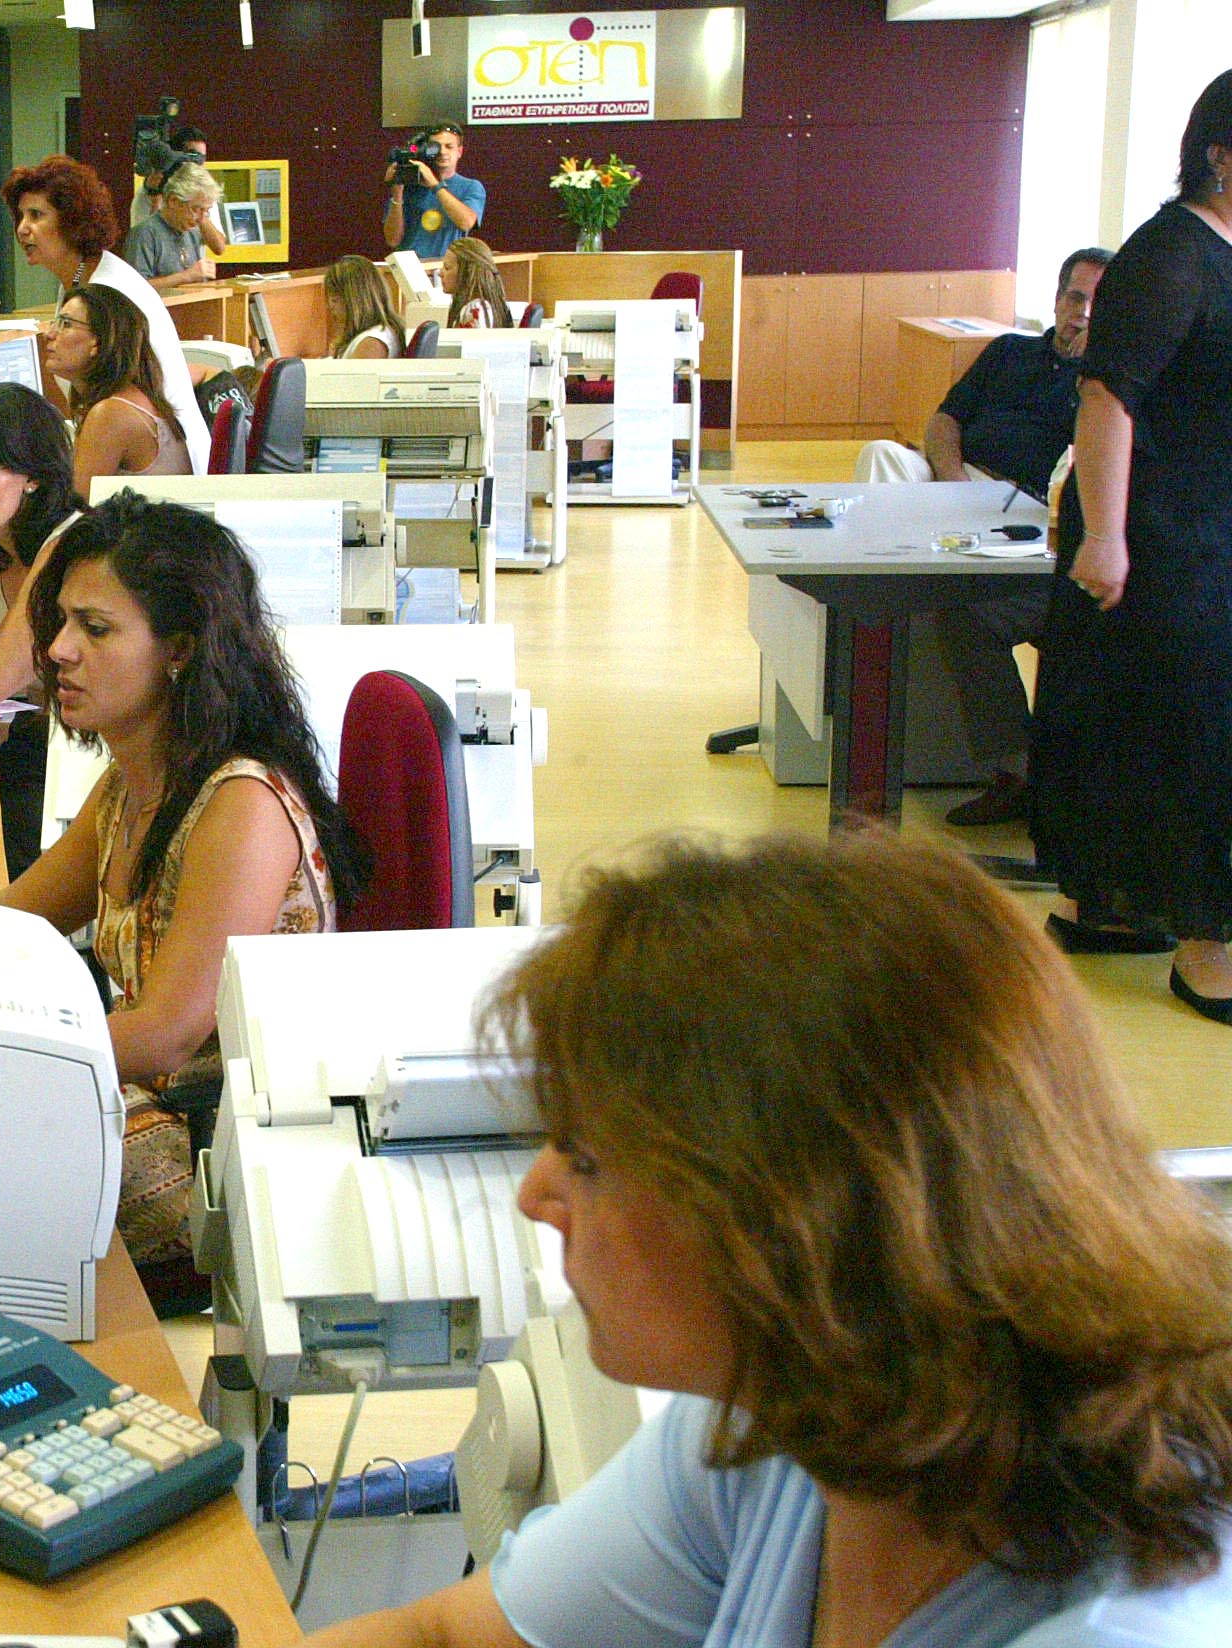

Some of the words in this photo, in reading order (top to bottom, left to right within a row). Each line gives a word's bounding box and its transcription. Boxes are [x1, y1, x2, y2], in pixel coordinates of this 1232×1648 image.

[474, 105, 524, 117] ΣΤΑΘΜΟΣ
[525, 103, 599, 116] ΕΞΥΠΗΡΕΤΗΣΗΣ
[599, 102, 648, 114] ΠΟΛΙΤΩΝ
